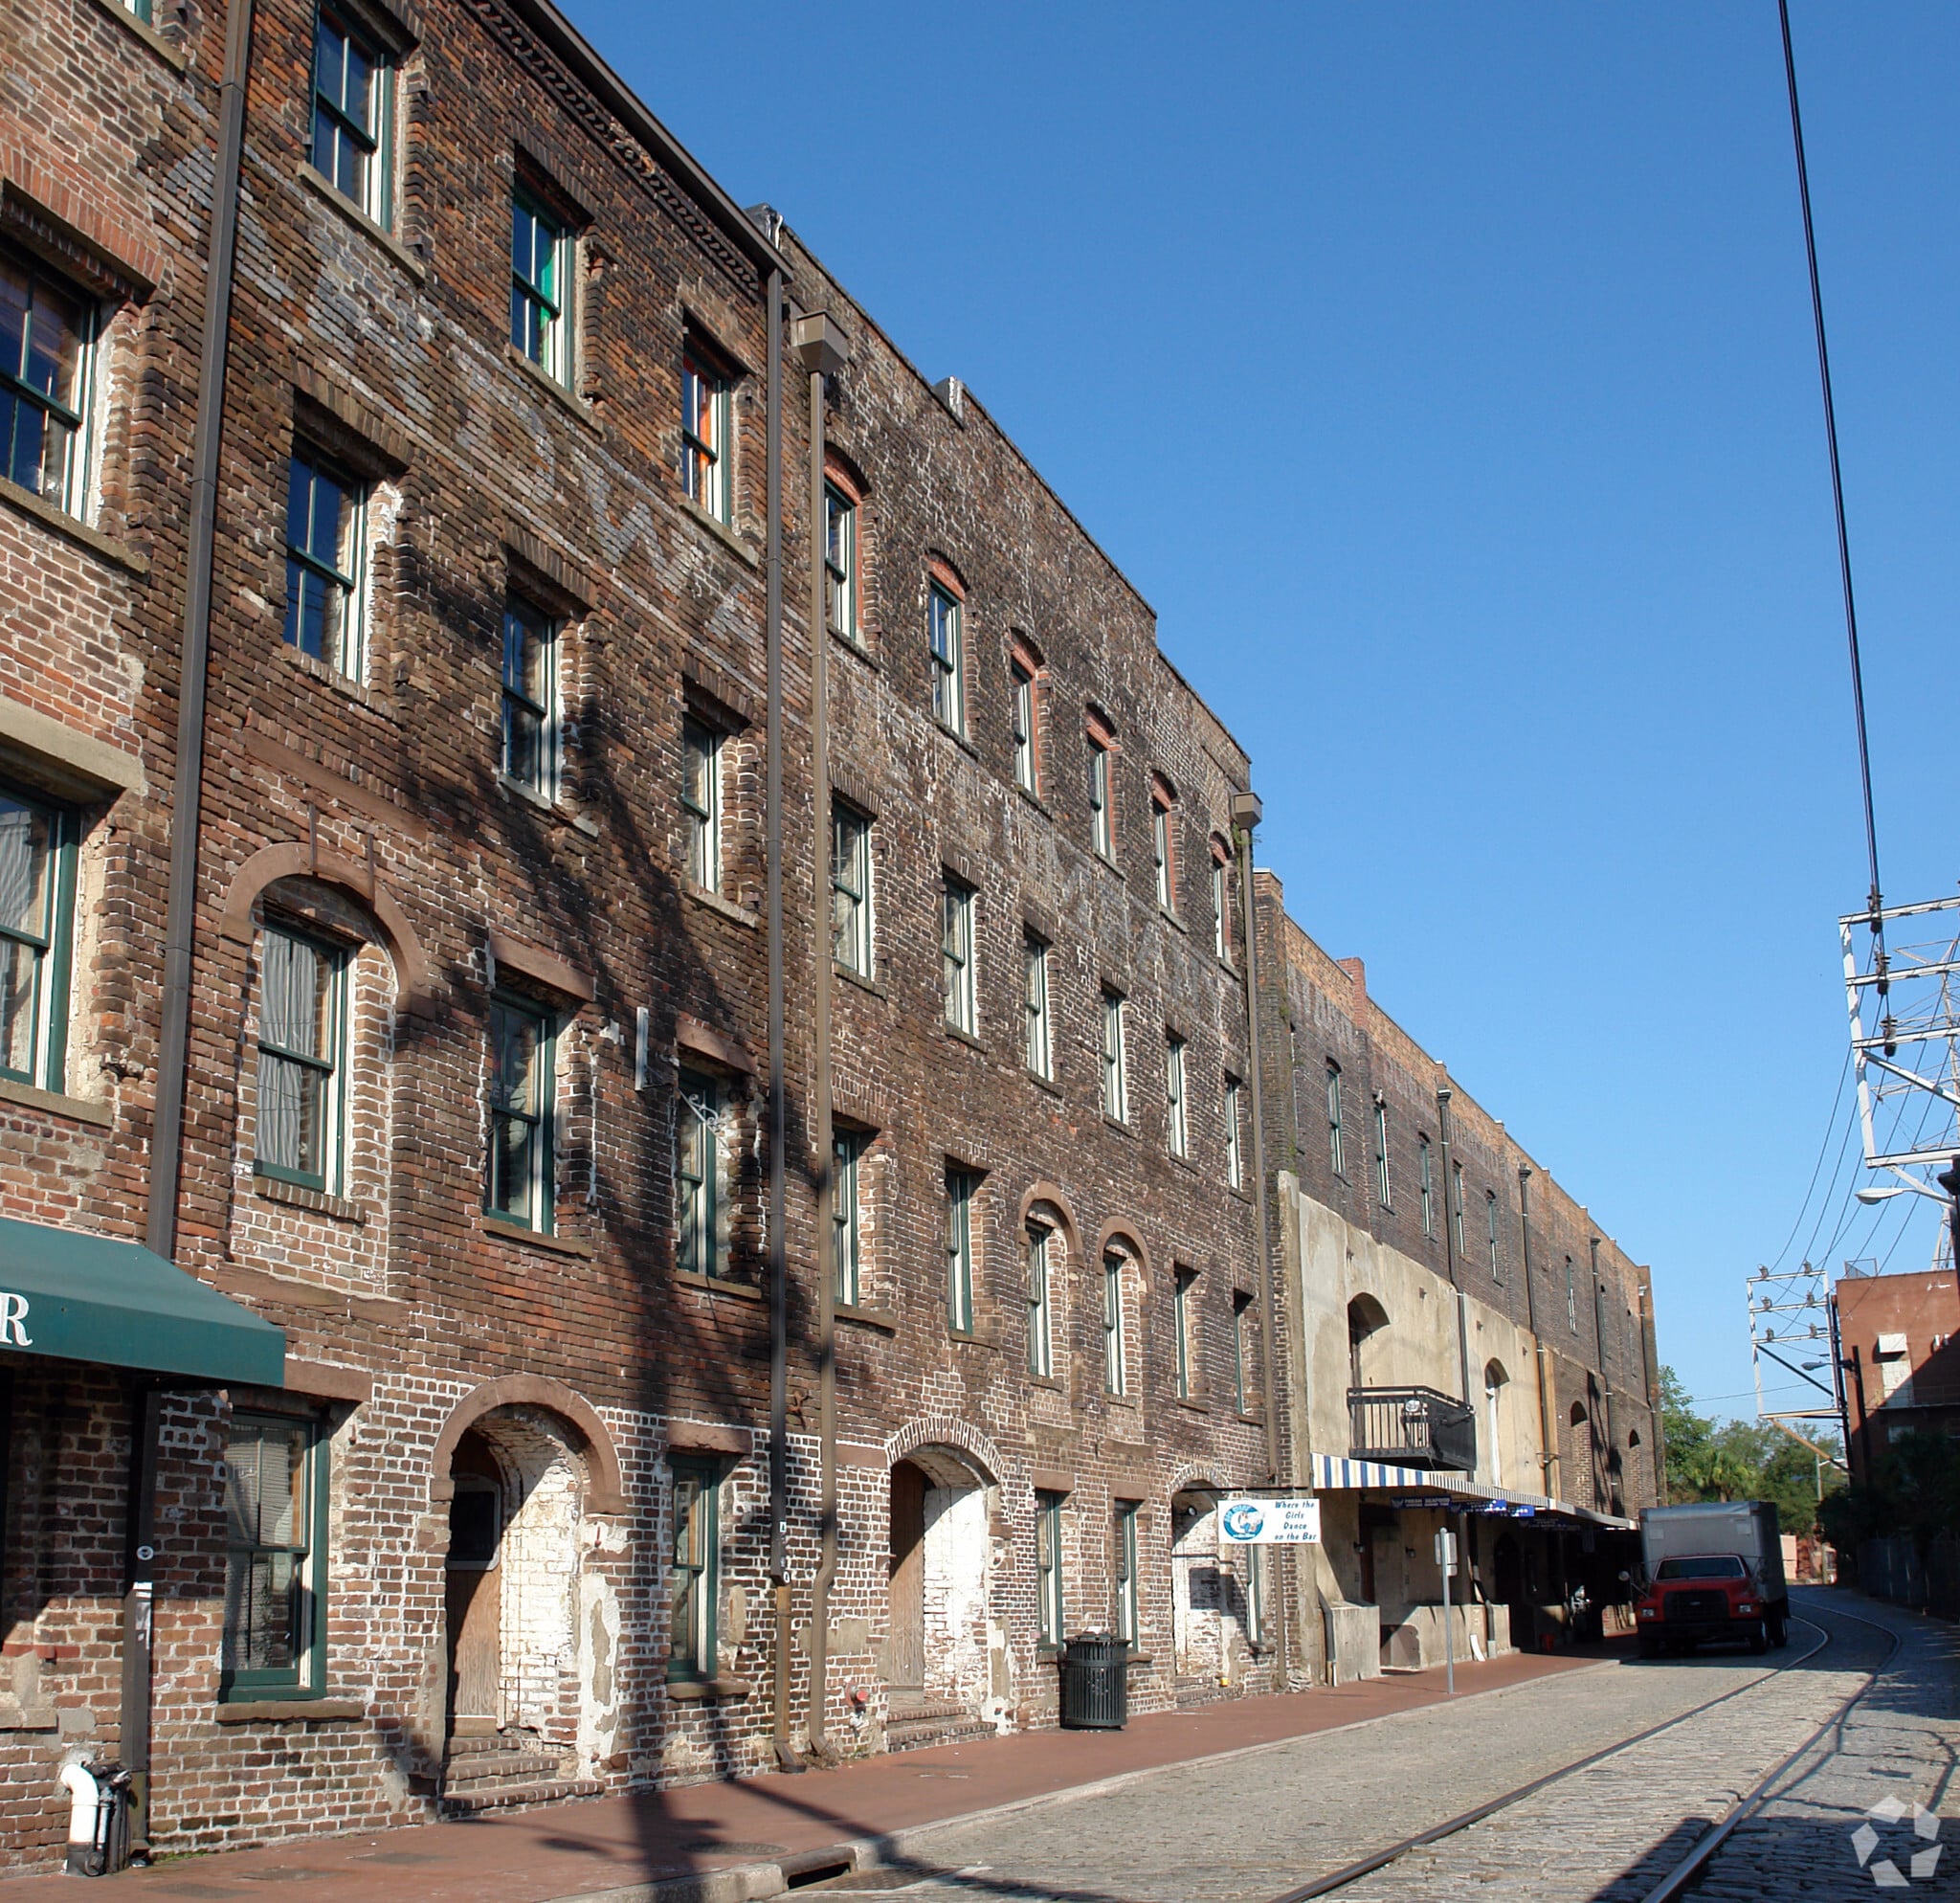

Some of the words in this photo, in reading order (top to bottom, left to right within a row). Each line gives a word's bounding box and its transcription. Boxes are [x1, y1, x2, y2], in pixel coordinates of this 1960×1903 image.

[0, 1292, 33, 1347] R
[1275, 1500, 1300, 1509] Where
[1303, 1500, 1315, 1509] the
[1285, 1511, 1304, 1519] Girls
[1283, 1521, 1307, 1530] Dance
[1287, 1532, 1300, 1540] the
[1303, 1532, 1317, 1540] Bar
